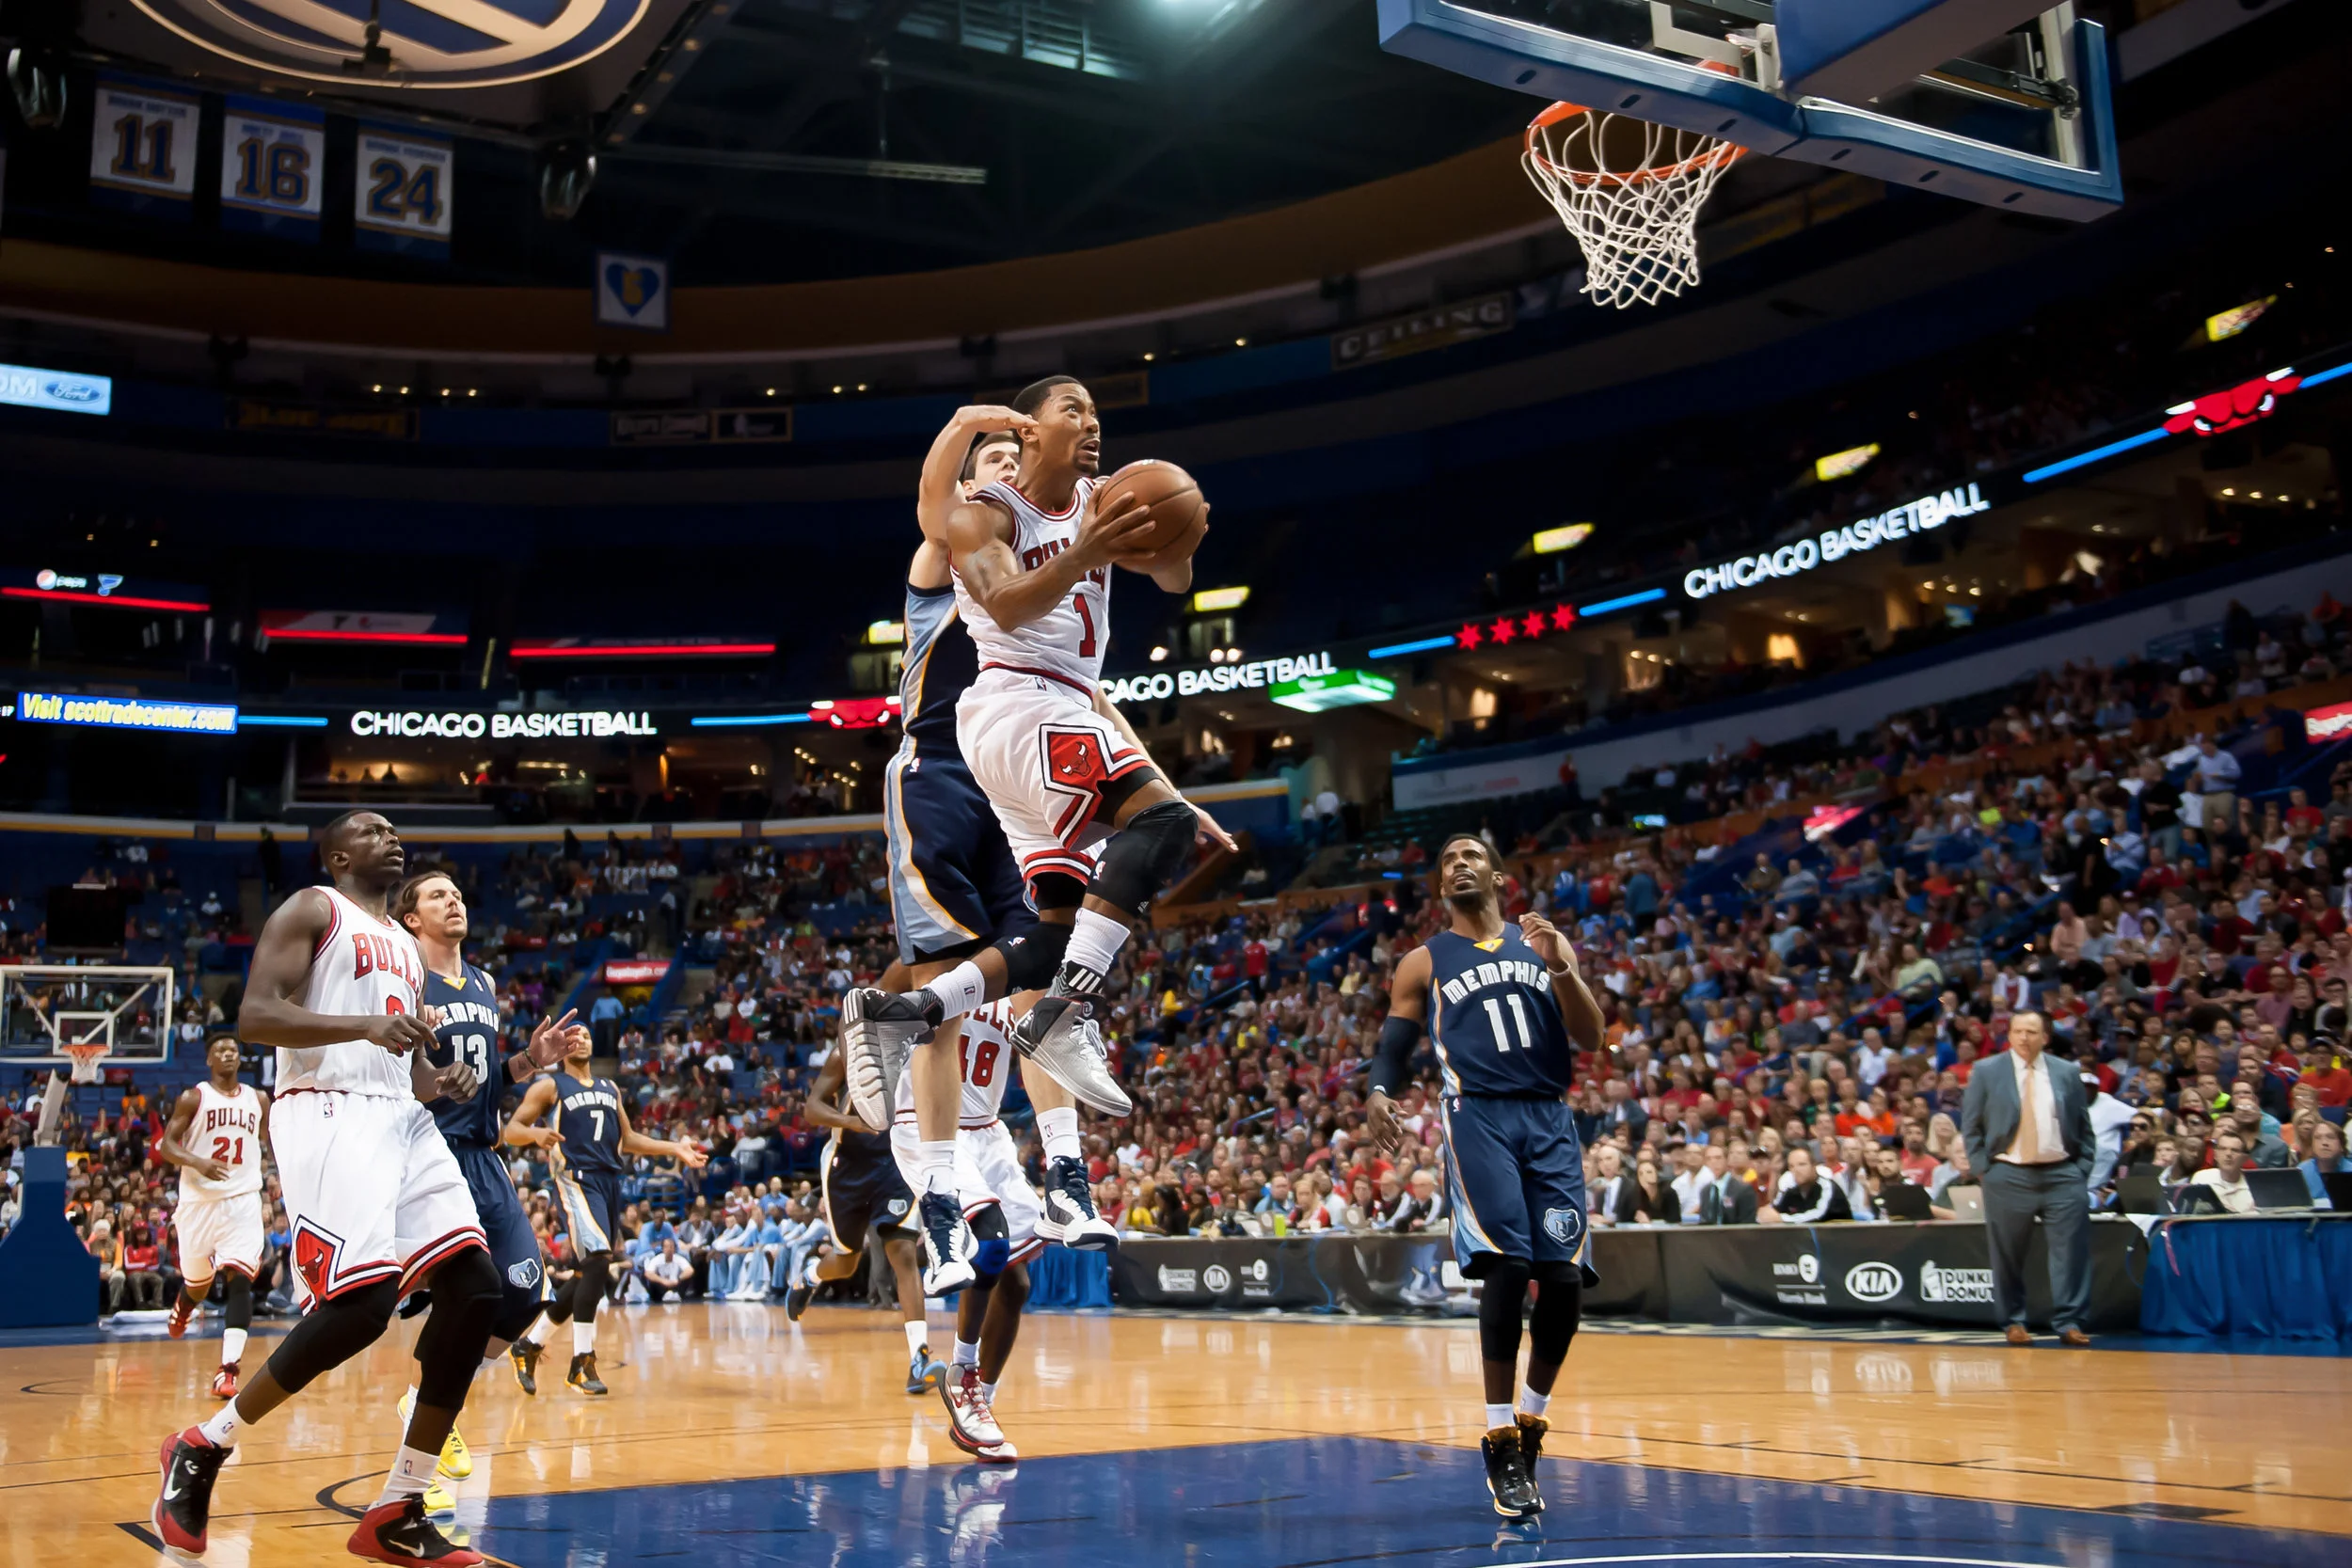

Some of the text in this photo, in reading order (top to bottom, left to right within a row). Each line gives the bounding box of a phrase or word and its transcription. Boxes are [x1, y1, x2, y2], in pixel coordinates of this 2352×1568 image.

[111, 113, 176, 183] 11
[236, 136, 310, 206] 16
[367, 157, 442, 226] 24
[1684, 482, 1991, 598] CHICAGO BASKETBALL
[1073, 593, 1097, 657] 1
[1099, 673, 1174, 704] CAGO
[1178, 651, 1338, 696] BASKETBALL
[24, 693, 63, 721] Visit
[350, 710, 657, 738] CHICAGO BASKETBALL
[1440, 960, 1550, 1005] MEMPHIS
[433, 1002, 500, 1033] EMPHI
[1483, 993, 1532, 1052] 11
[451, 1034, 488, 1085] 13
[206, 1107, 256, 1134] BULLS
[590, 1110, 604, 1142] 7
[212, 1136, 243, 1165] 21
[1854, 1271, 1894, 1293] KIA
[1946, 1271, 1993, 1285] DUNKI
[1946, 1285, 1994, 1301] DONUT
